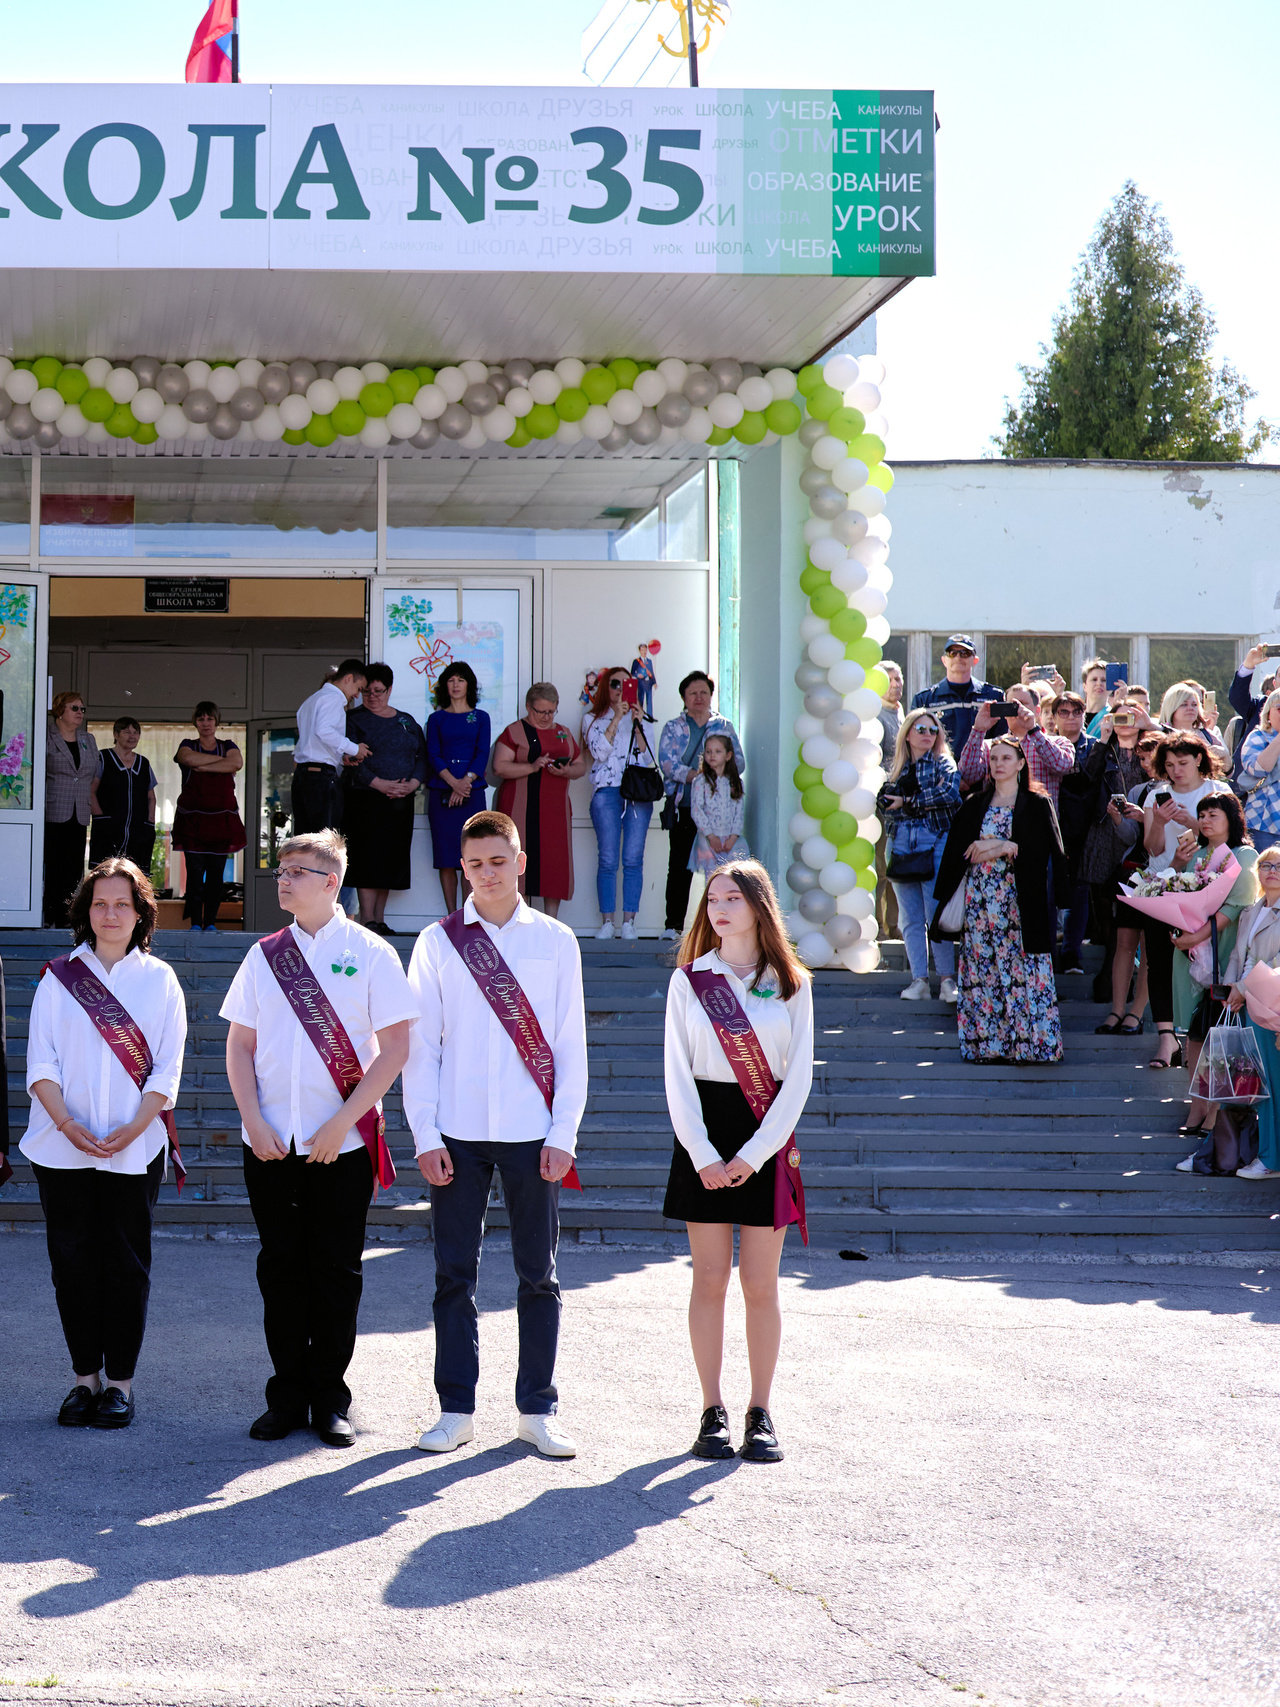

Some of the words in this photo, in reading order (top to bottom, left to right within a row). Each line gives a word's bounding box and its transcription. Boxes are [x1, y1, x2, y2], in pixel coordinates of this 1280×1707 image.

[289, 96, 365, 116] УЧЕБА
[380, 103, 445, 114] КАНИКУЛЫ
[457, 101, 530, 117] ШКОЛА
[538, 98, 633, 122] ДРУЗЬЯ
[653, 106, 684, 117] УРОК
[696, 103, 754, 117] ШКОЛА
[765, 100, 842, 121] УЧЕБА
[858, 105, 922, 116] КАНИКУЛЫ
[712, 139, 758, 151] ДРУЗЬЯ
[769, 128, 923, 155] ОТМЕТКИ
[407, 147, 539, 224] №
[568, 126, 704, 225] 35
[747, 172, 923, 193] ОБРАЗОВАНИЕ
[748, 211, 811, 225] ШКОЛА
[834, 205, 923, 232] УРОК
[457, 239, 529, 256] ШКОЛА
[537, 236, 632, 260] ДРУЗЬЯ
[653, 244, 684, 255] УРОК
[695, 241, 753, 255] ШКОЛА
[765, 239, 842, 259] УЧЕБА
[858, 243, 922, 254] КАНИКУЛЫ
[45, 528, 128, 537] ИЗБИРАТЕЛЬНЫЙ
[46, 539, 90, 547] УЧАСТОК
[156, 598, 193, 606] ШКОЛА
[489, 972, 539, 1055] Выпускник
[293, 977, 343, 1059] Выпускник
[335, 1056, 361, 1088] 202
[725, 1018, 769, 1100] Выпускница
